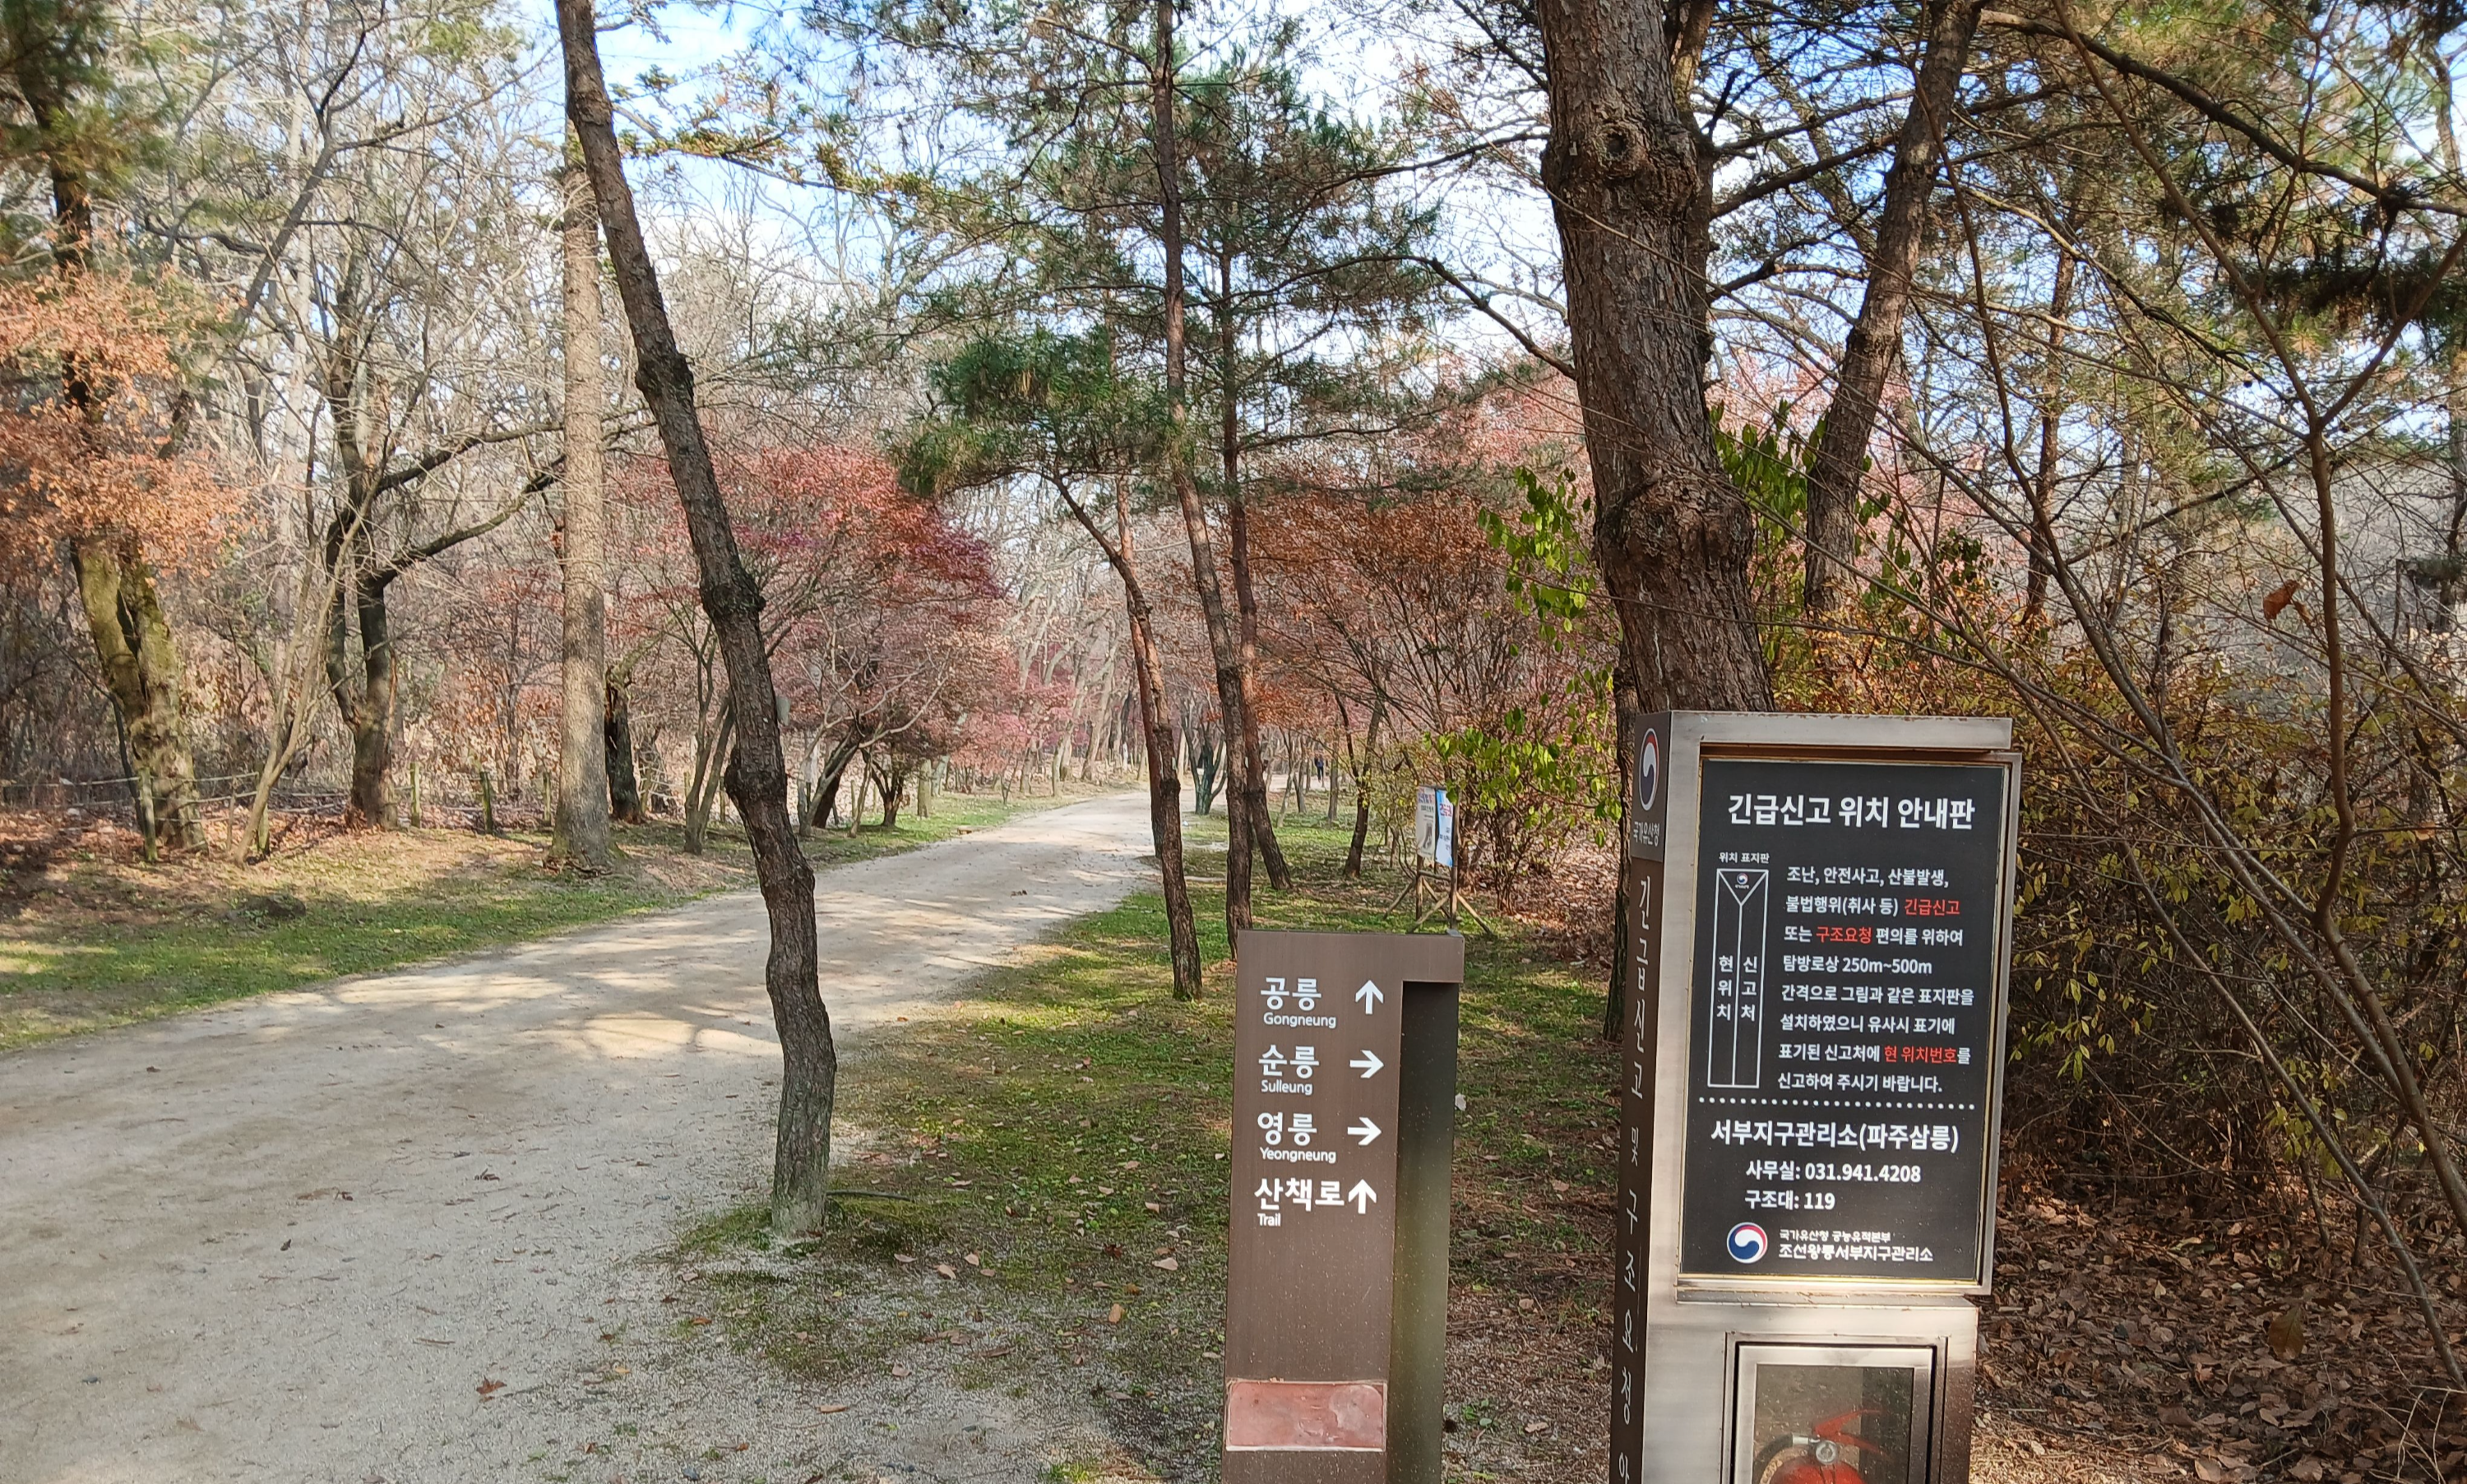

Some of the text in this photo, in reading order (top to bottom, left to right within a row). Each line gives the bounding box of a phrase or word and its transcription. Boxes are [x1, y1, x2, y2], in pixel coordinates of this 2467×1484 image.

[1728, 793, 1975, 830] 긴급신고 위치 안내판
[1633, 821, 1659, 847] 국가유산청
[1719, 852, 1770, 864] 위치 표지판
[1786, 867, 1949, 888] 조난, 안전사고, 산불발생,
[1785, 895, 1960, 916] 불법행위(취사 등) 긴급신고
[1784, 927, 1964, 946] 또는 구조요청 편의를 위하여
[1783, 955, 1932, 974] 탐방로상 250m~500m
[1261, 977, 1322, 1011] 공릉
[1631, 876, 1651, 1099] 긴급신고
[1781, 985, 1974, 1006] 간격으로 그림과 같은 표지판을
[1263, 1013, 1336, 1029] Gongneung
[1780, 1015, 1956, 1035] 설치하였으니 유사시 표기에
[1258, 1045, 1320, 1079] 순릉
[1778, 1044, 1971, 1065] 표기된 신고처에 현 위치번호를
[1261, 1079, 1312, 1095] Sulleung
[1777, 1073, 1943, 1093] 신고하여 주시기 바랍니다.
[1257, 1112, 1317, 1146] 영릉
[1710, 1119, 1959, 1152] 서부지구관리소(파주삼릉)
[1260, 1147, 1336, 1163] Yeongneung
[1631, 1126, 1640, 1167] 및
[1746, 1160, 1921, 1183] 사무실: 031.941.4208
[1254, 1177, 1345, 1211] 산책로
[1744, 1190, 1835, 1210] 구조대: 119
[1257, 1214, 1281, 1227] Trail
[1780, 1229, 1828, 1241] 국가유산청
[1779, 1243, 1934, 1262] 조선왕릉서부지구관리소
[1620, 1188, 1638, 1425] 구조요청
